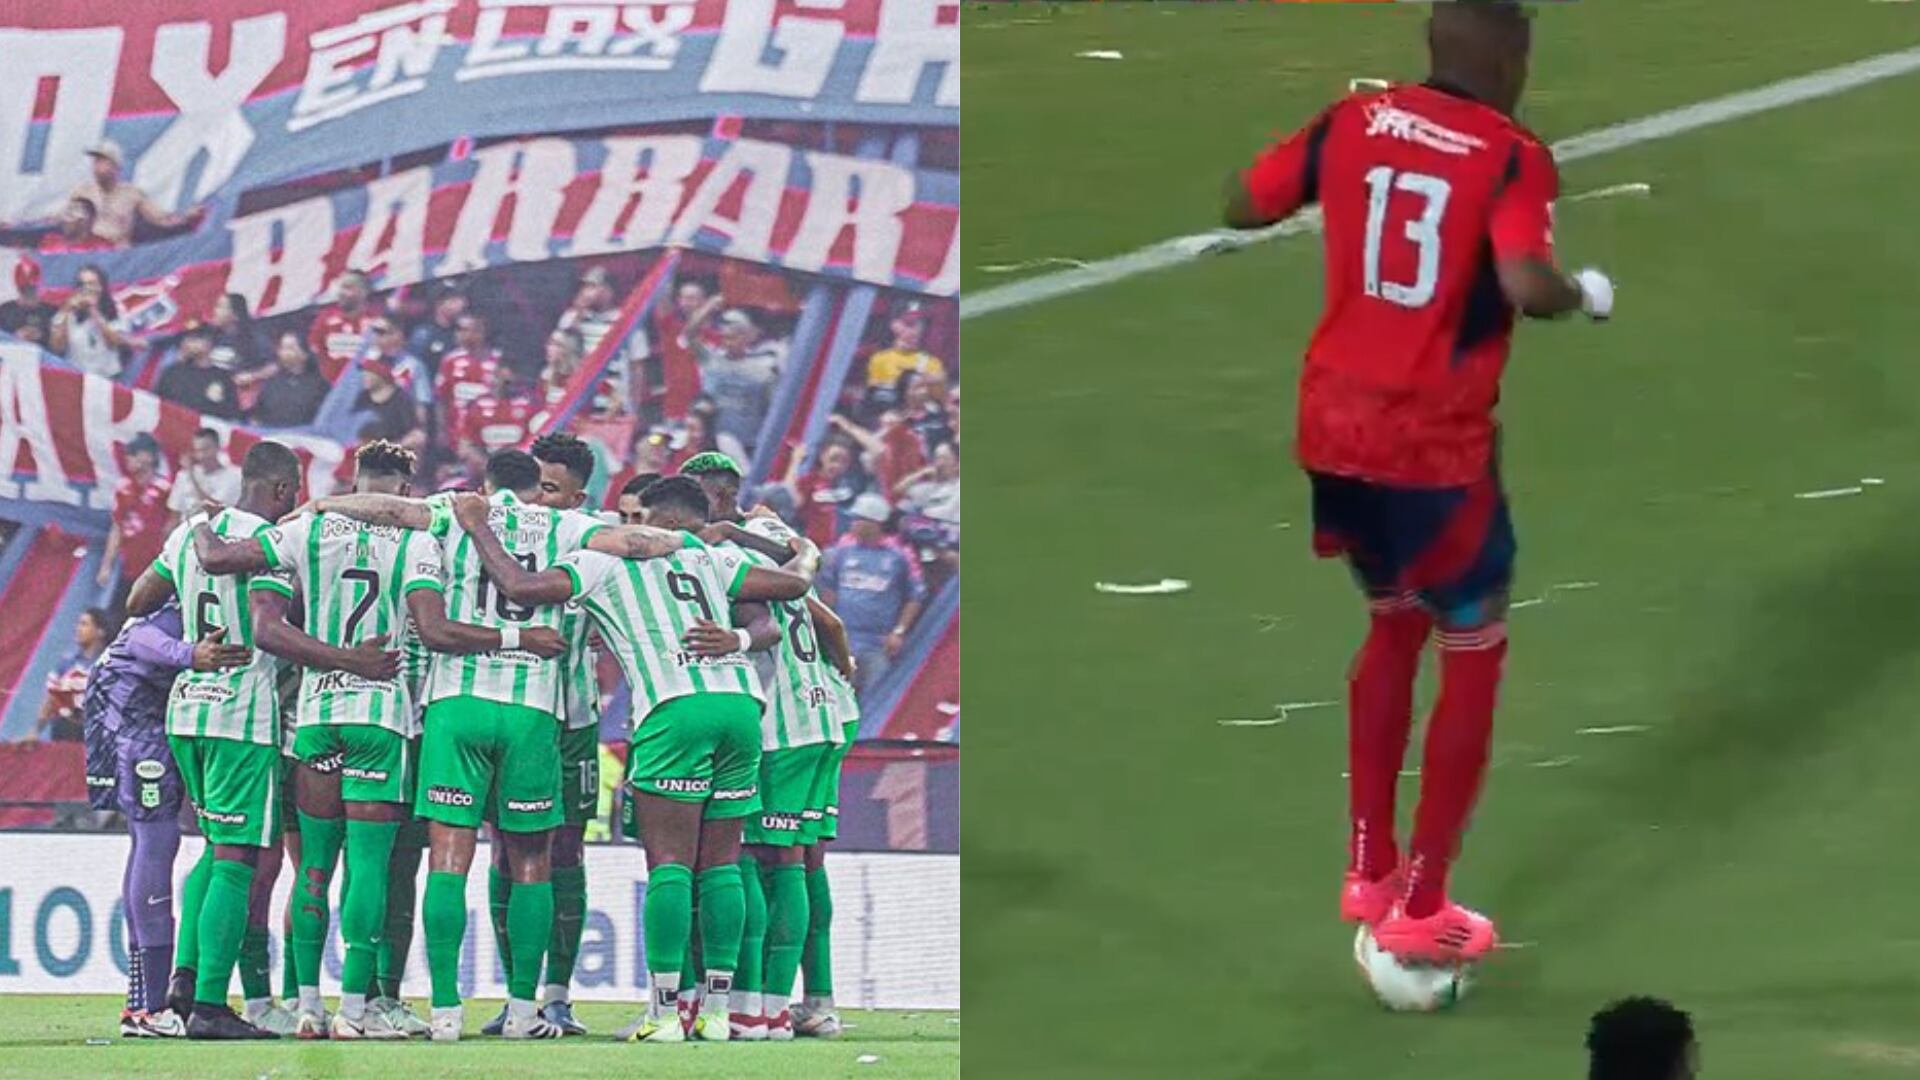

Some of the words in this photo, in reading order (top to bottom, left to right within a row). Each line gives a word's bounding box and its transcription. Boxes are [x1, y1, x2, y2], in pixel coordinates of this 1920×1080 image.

[1363, 165, 1451, 309] 13
[197, 592, 229, 642] 6
[341, 567, 380, 644] 7
[666, 569, 713, 621] 9
[315, 671, 345, 694] JFK
[427, 788, 473, 806] UNICO
[867, 761, 928, 851] 1
